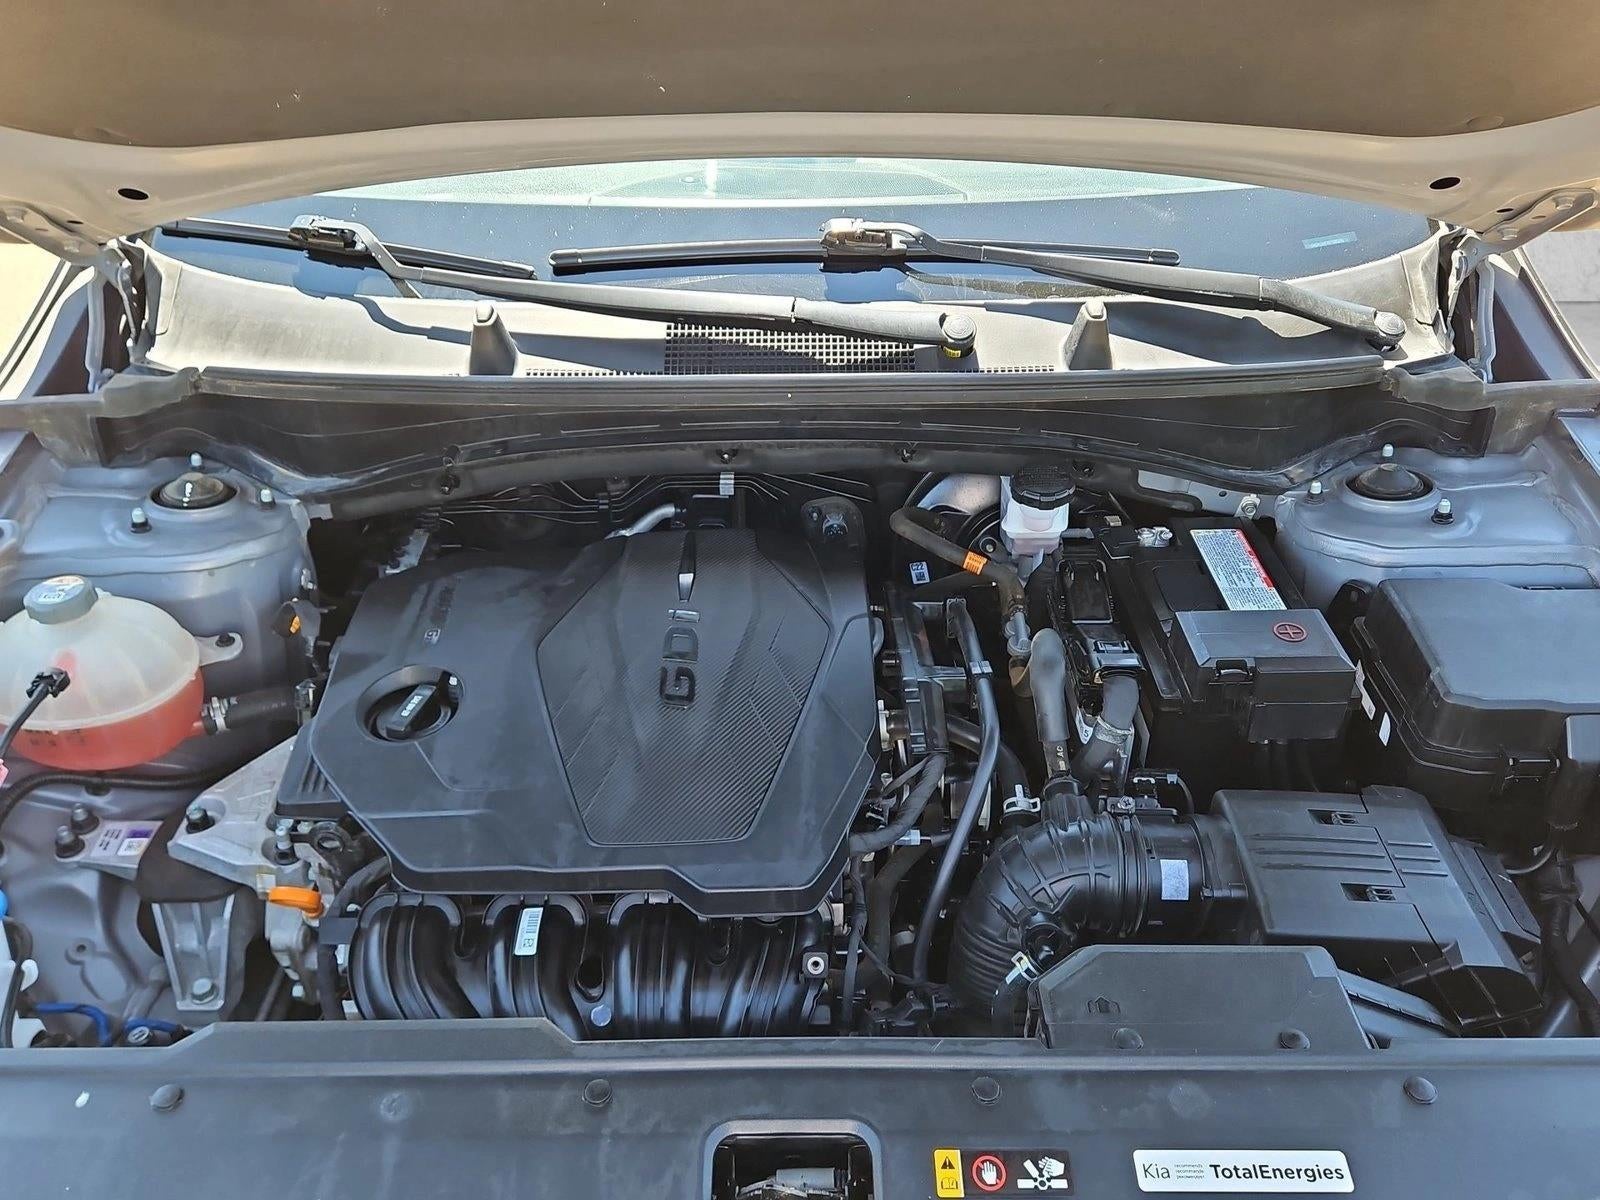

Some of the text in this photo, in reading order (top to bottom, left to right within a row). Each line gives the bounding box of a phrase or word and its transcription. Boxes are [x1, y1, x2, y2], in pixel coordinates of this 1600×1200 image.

[660, 609, 700, 707] GDI
[1142, 1163, 1171, 1179] Kia
[1209, 1164, 1345, 1183] TotalEnergies
